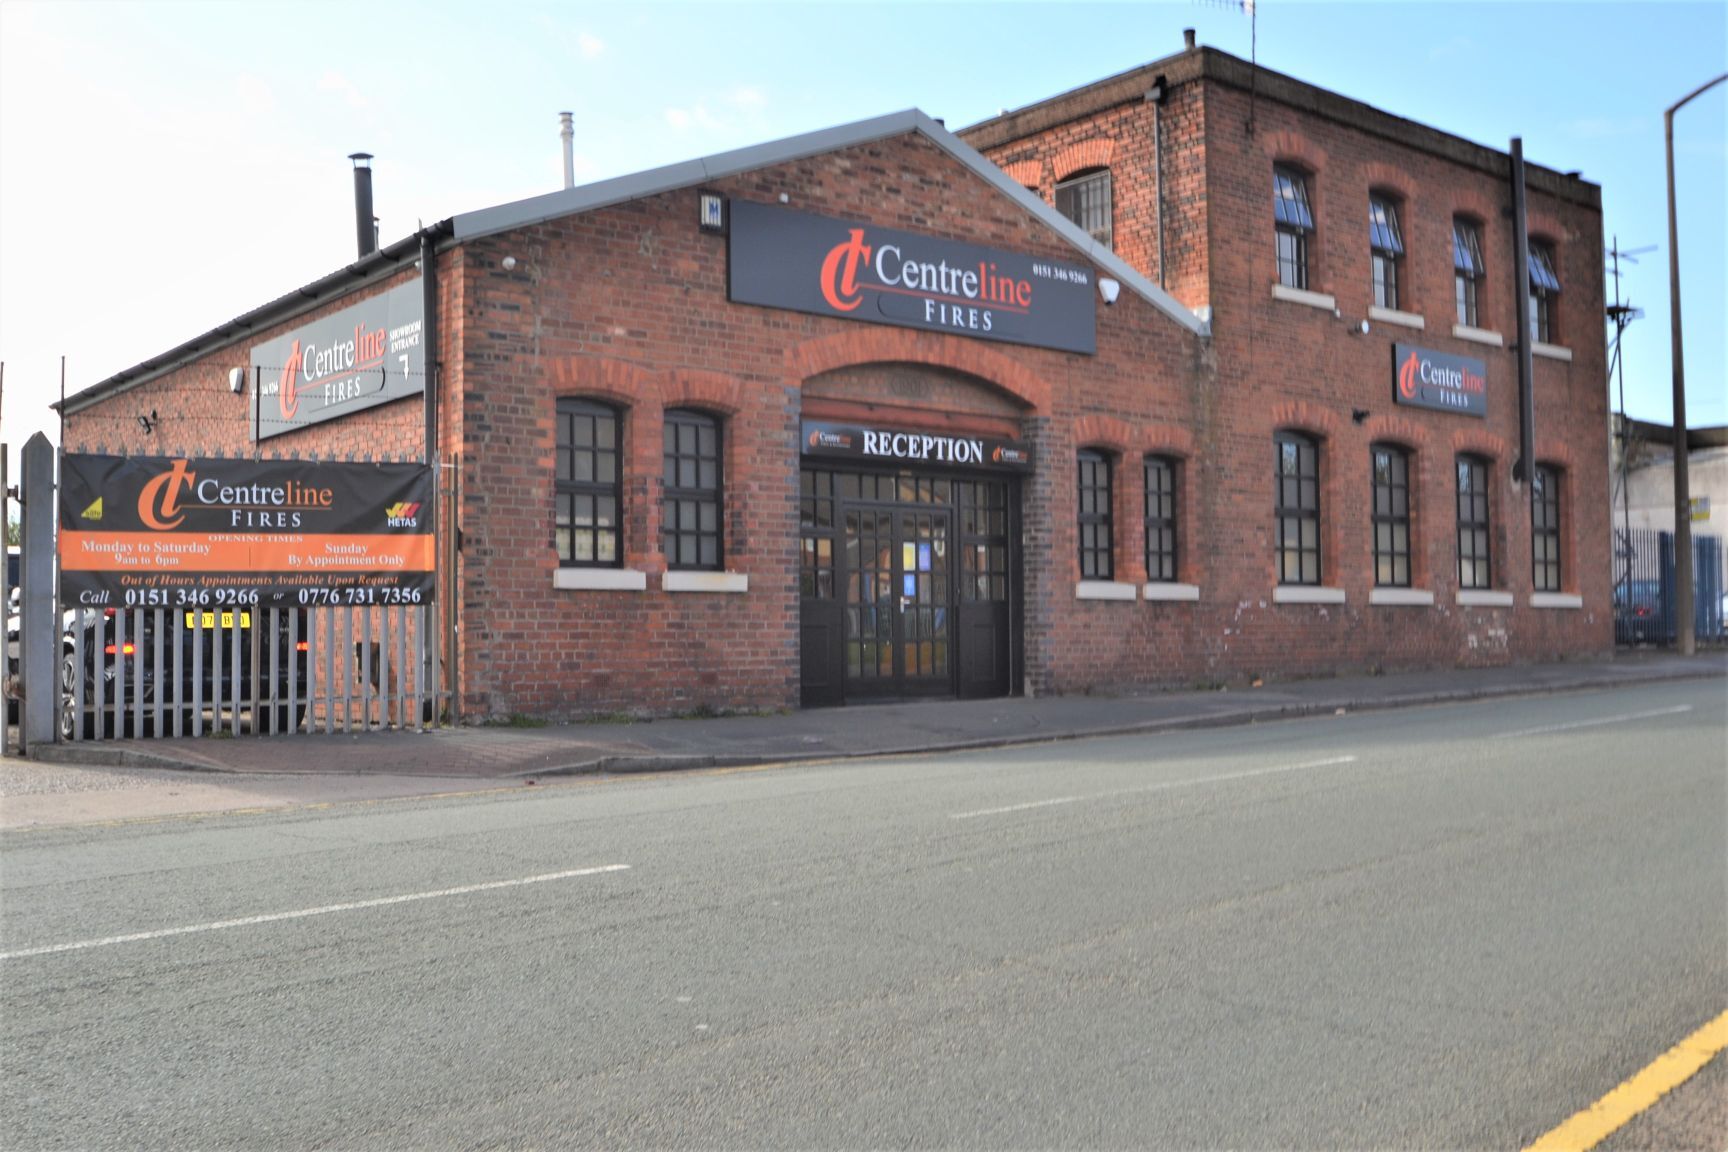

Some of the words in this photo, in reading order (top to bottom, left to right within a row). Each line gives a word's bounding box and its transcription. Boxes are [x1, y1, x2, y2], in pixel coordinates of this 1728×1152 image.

[876, 244, 1032, 307] Centreline
[1032, 263, 1051, 278] 0151
[1053, 266, 1068, 281] 346
[1068, 270, 1088, 285] 9266
[924, 299, 992, 331] FIRES
[389, 319, 422, 341] SHOWROOM
[303, 322, 387, 381] Centreline
[391, 333, 420, 354] ENTRANCE
[1420, 359, 1484, 394] Centreline
[324, 376, 361, 406] FIRES
[1440, 387, 1469, 408] FIRES
[863, 430, 983, 464] RECEPTION
[197, 478, 333, 506] Centreline
[231, 509, 301, 528] FIRES
[387, 517, 417, 528] HETAS
[81, 539, 134, 556] Monday
[138, 542, 150, 553] to
[153, 541, 211, 556] Saturday
[208, 533, 262, 543] OPENING
[268, 534, 303, 543] TIMES
[114, 553, 138, 565] 9am
[141, 556, 151, 565] to
[155, 553, 179, 567] 6pm
[325, 543, 368, 556] Sunday
[288, 554, 303, 567] By
[306, 554, 376, 567] Appointment
[378, 554, 405, 567] Only
[121, 574, 142, 586] Out
[145, 574, 159, 588] of
[160, 574, 195, 586] Hours
[196, 574, 273, 588] Appointments
[275, 574, 324, 586] Available
[327, 574, 355, 587] Upon
[358, 574, 399, 587] Request
[80, 589, 110, 604] Call
[125, 588, 169, 606] 0151
[175, 588, 210, 605] 346
[215, 588, 260, 605] 9266
[273, 592, 284, 600] or
[298, 588, 341, 605] 0776
[345, 587, 375, 604] 731
[381, 587, 421, 604] 7356
